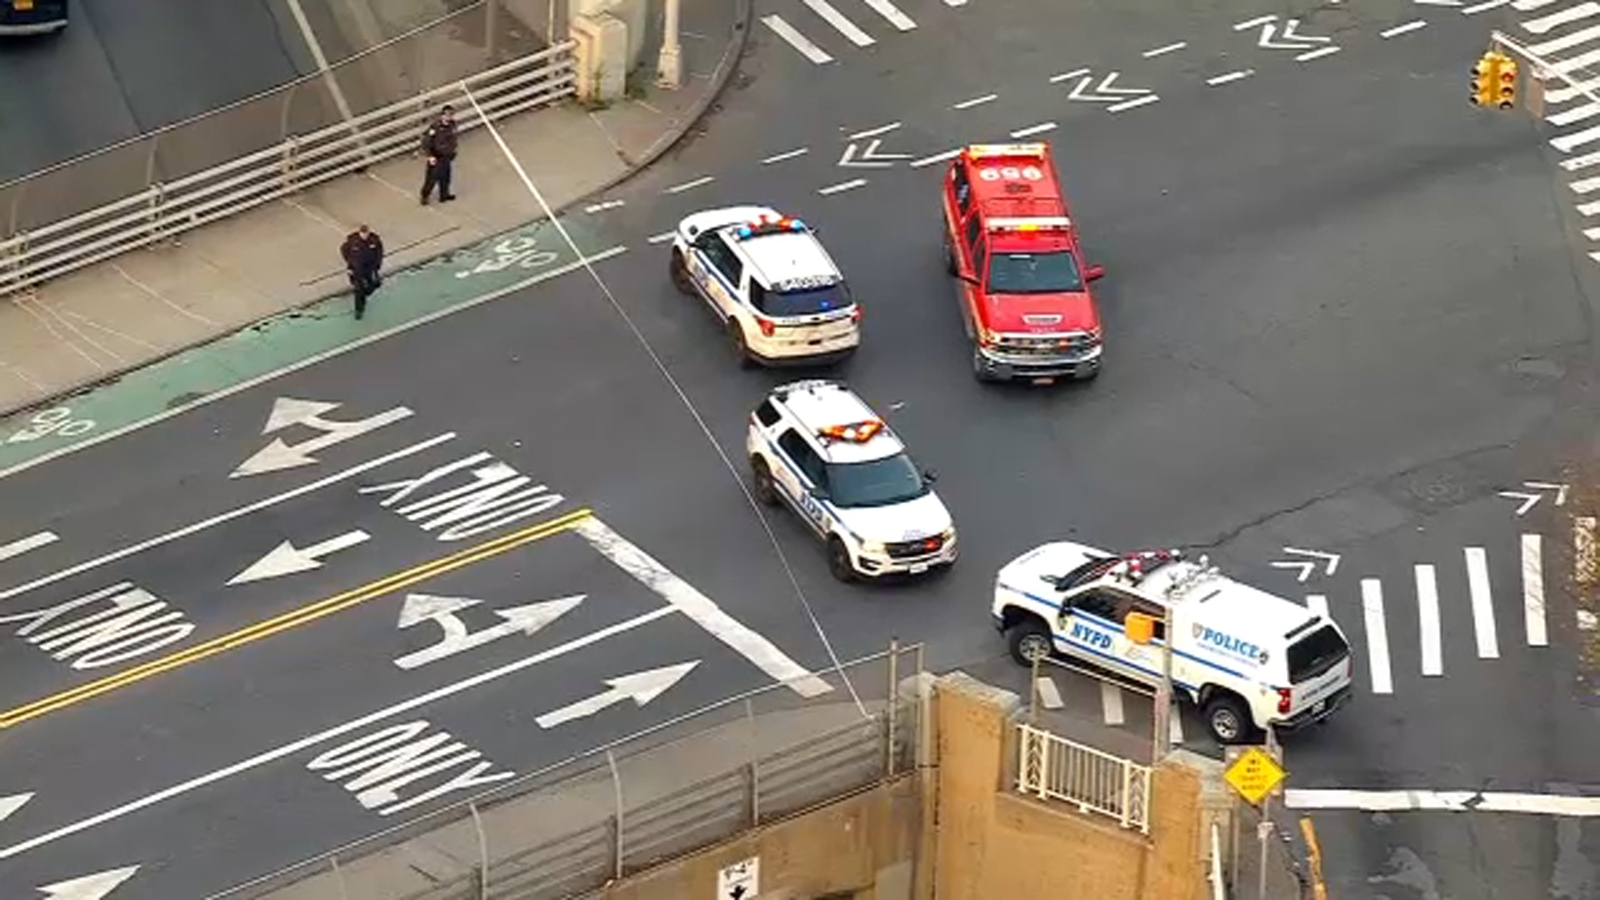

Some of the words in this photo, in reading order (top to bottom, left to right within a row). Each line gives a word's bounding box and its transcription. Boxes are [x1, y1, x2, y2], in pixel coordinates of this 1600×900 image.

[358, 451, 565, 542] ONLY
[0, 581, 196, 671] ONLY
[1070, 623, 1112, 650] NYPD
[1203, 627, 1260, 659] POLICE
[306, 719, 516, 817] ONLY
